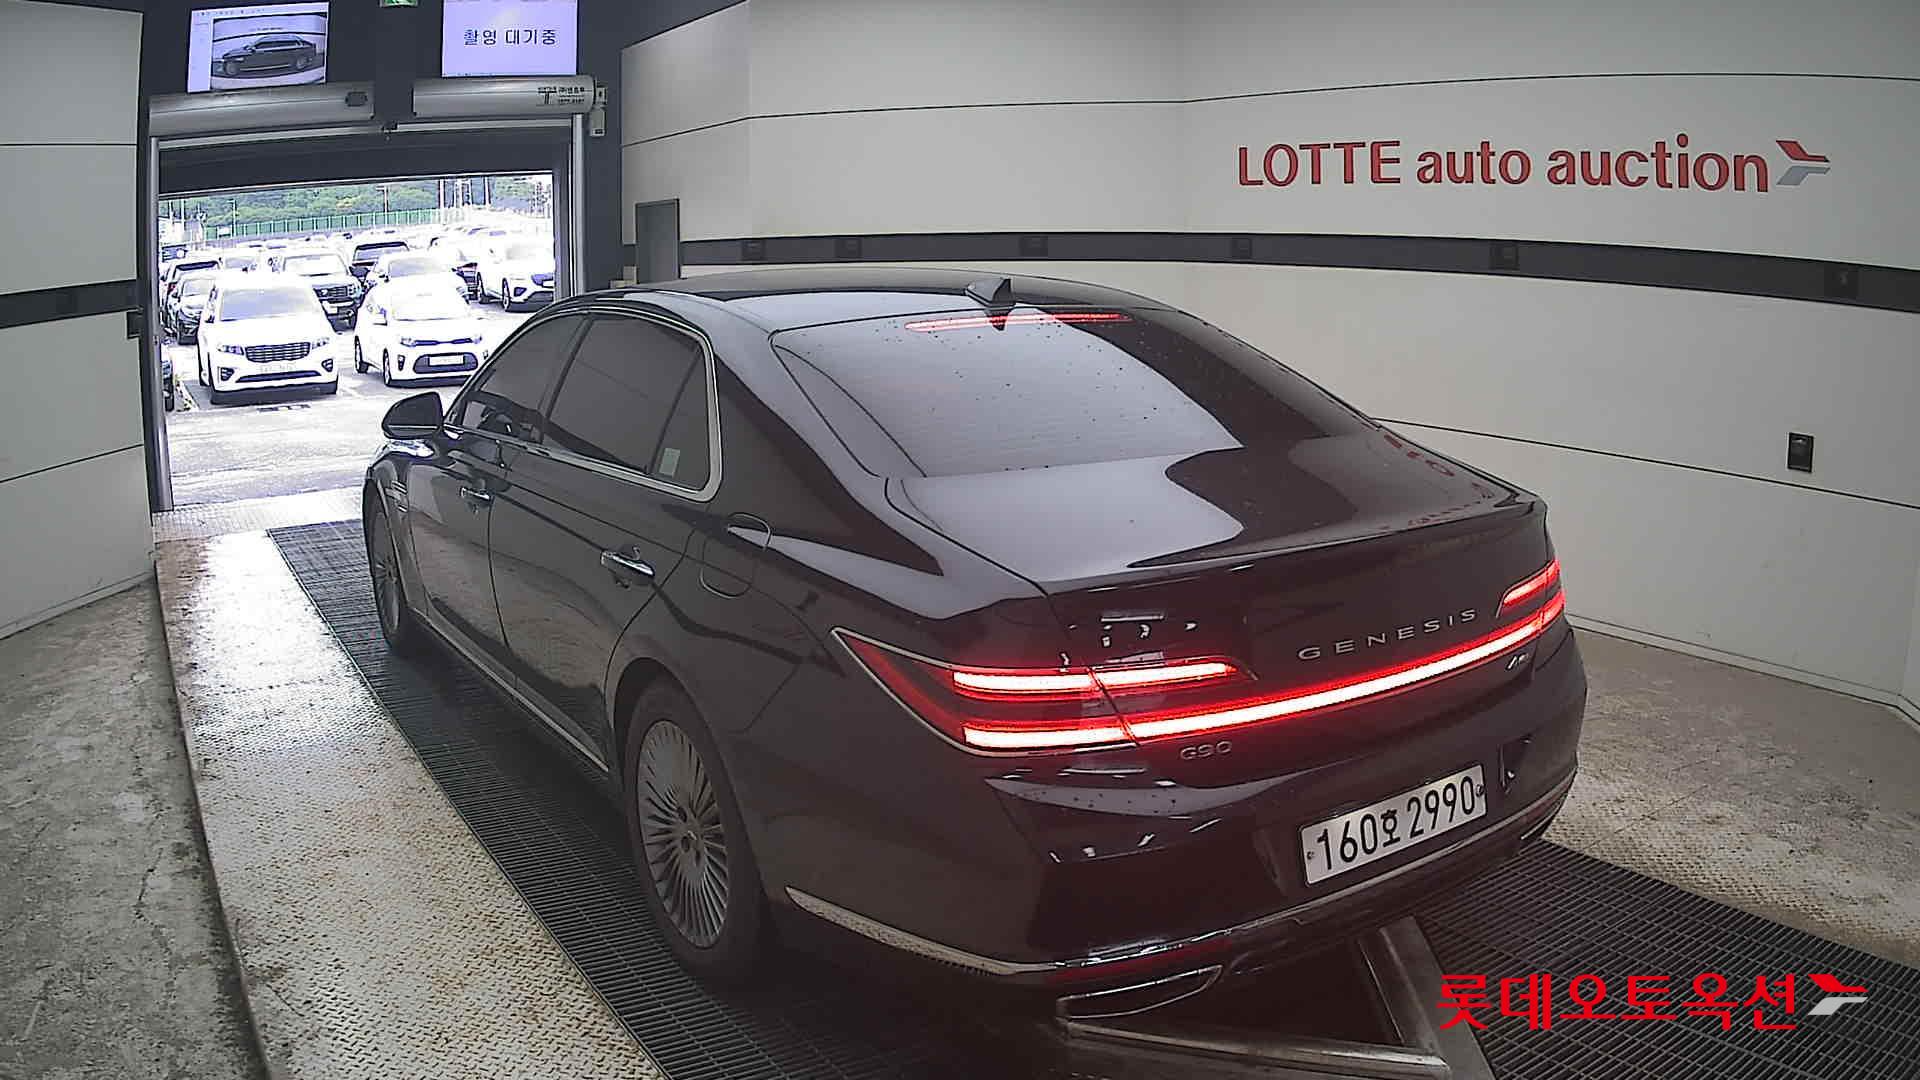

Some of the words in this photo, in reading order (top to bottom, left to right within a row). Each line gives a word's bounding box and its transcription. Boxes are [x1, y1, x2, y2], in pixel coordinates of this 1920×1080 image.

[505, 29, 556, 45] 대기중
[1239, 140, 1400, 186] LOTTE
[1416, 140, 1531, 185] auto
[1546, 133, 1768, 193] auction
[1298, 607, 1477, 661] GENESIS
[1180, 740, 1232, 760] G90
[1407, 775, 1475, 839] 2990
